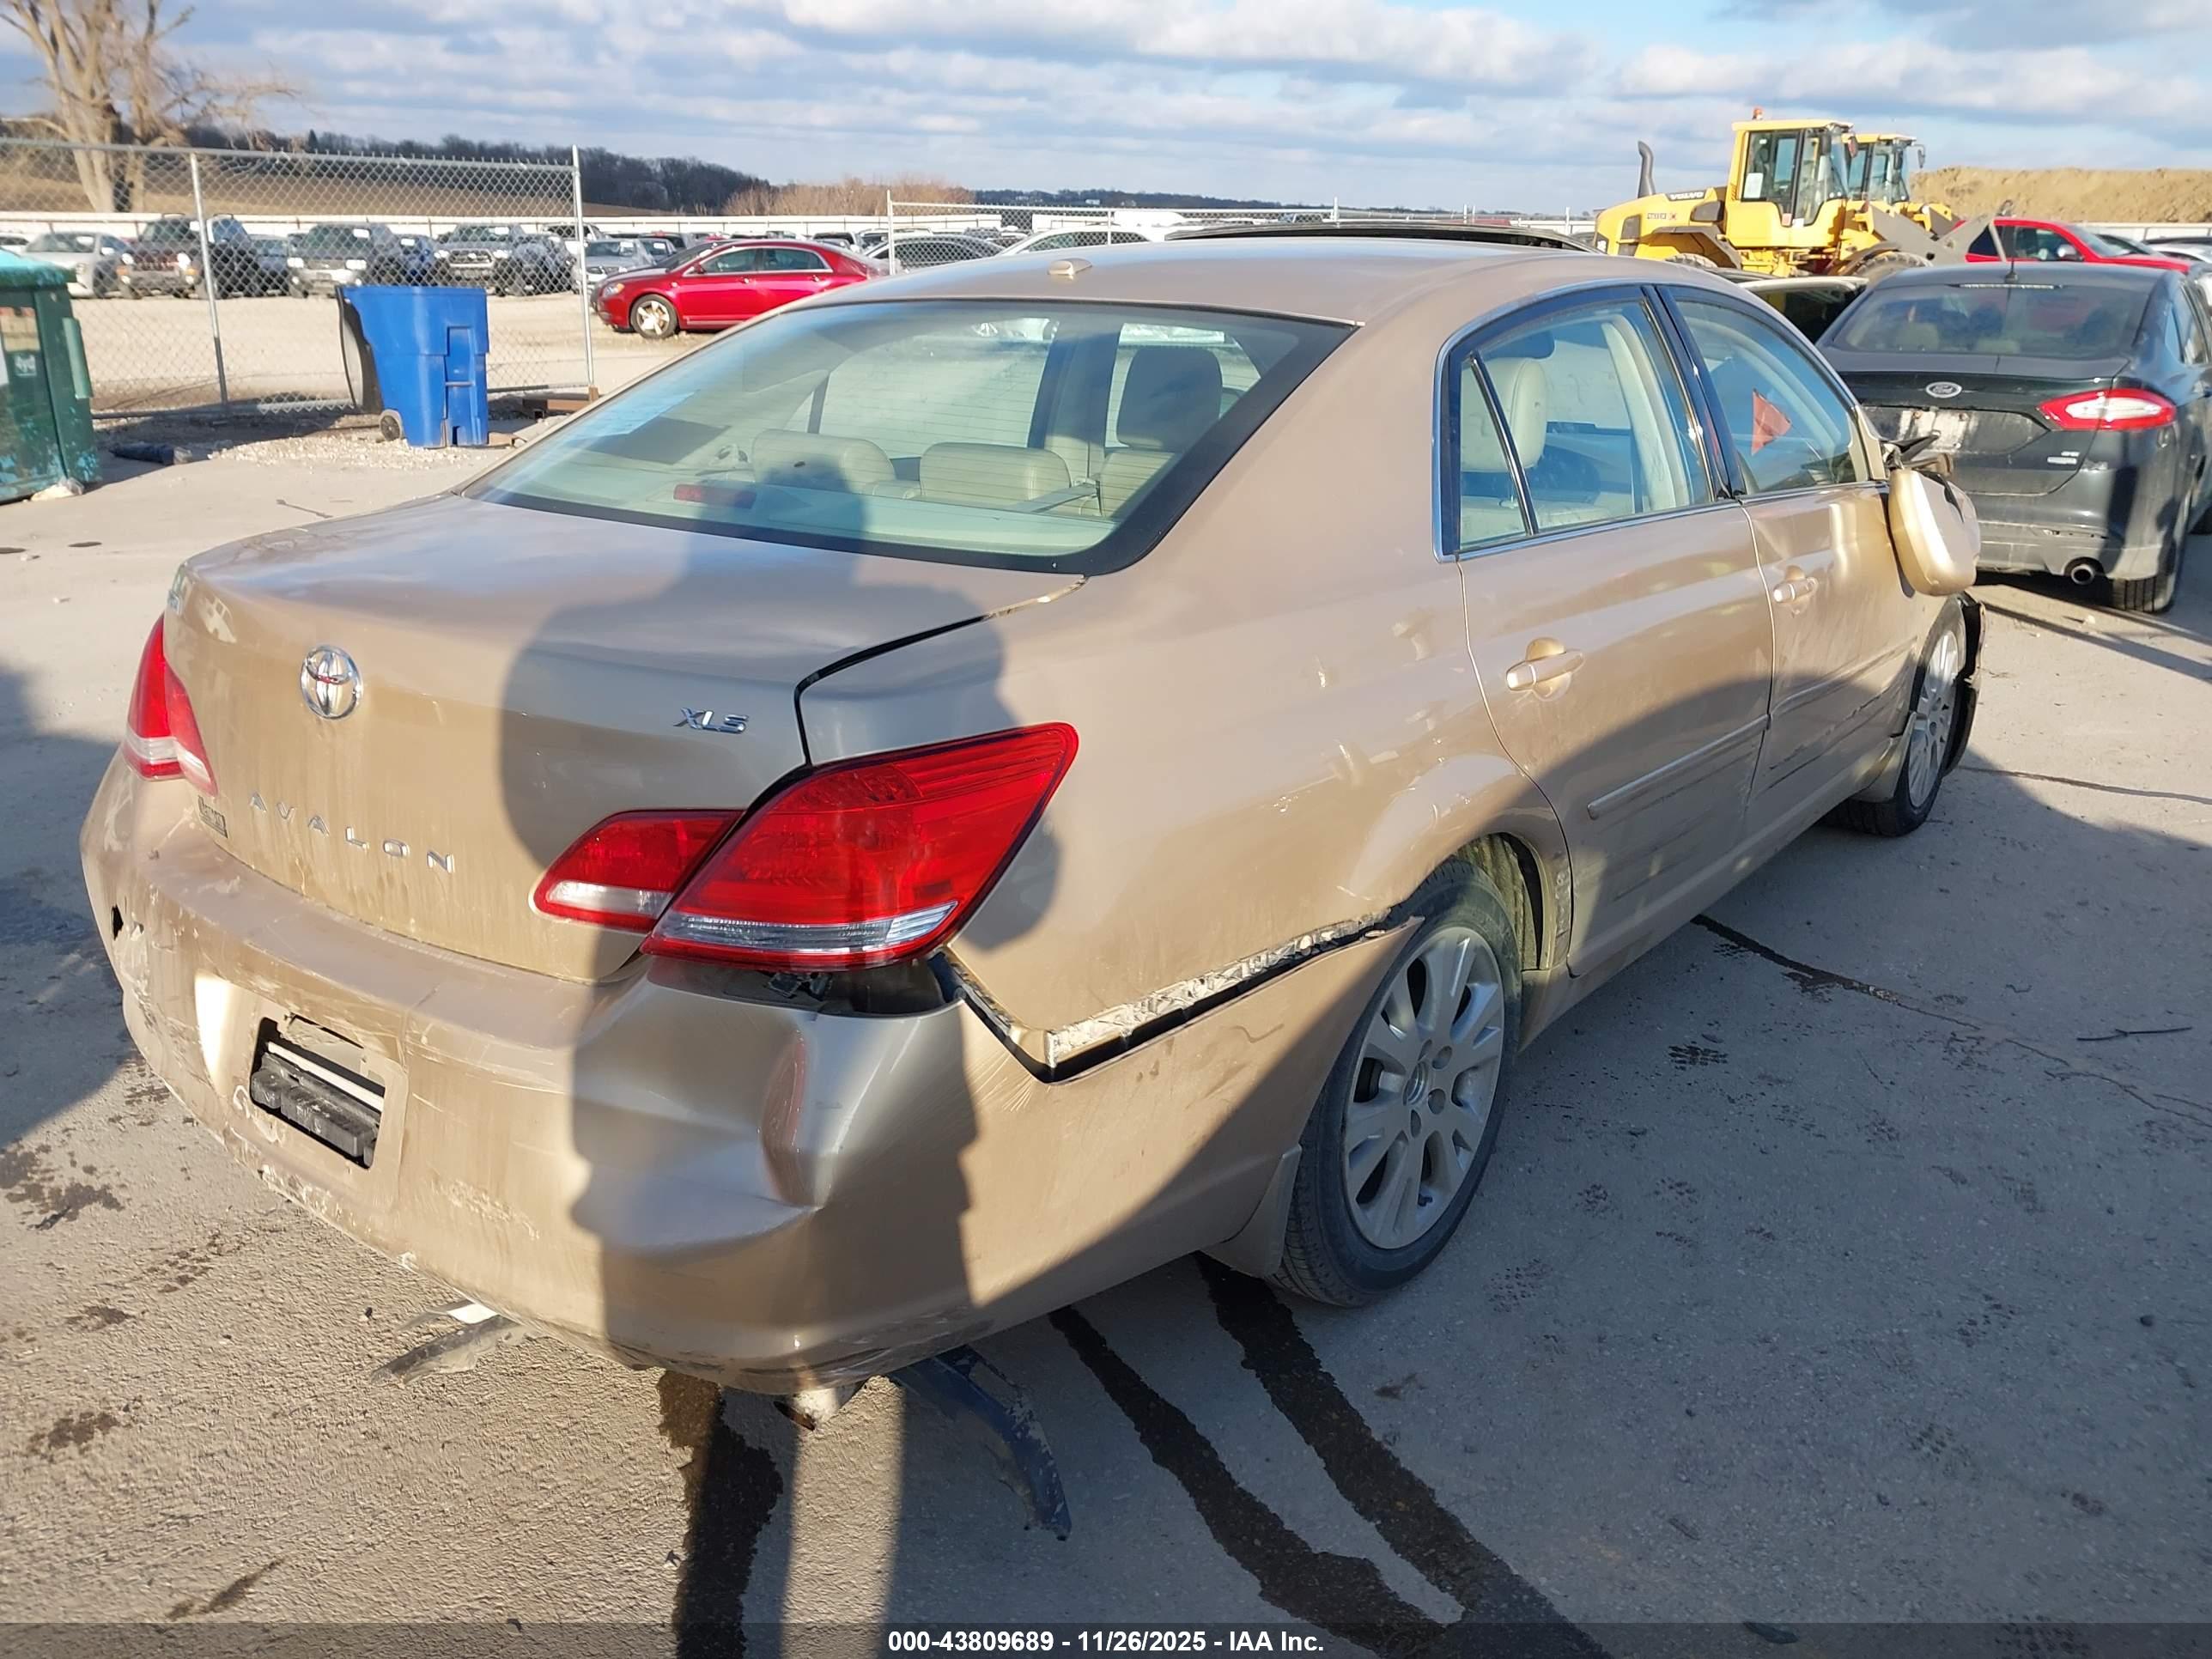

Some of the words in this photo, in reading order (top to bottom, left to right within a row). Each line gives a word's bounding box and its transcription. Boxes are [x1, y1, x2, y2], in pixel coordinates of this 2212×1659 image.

[1669, 191, 1705, 200] VOLVO
[673, 708, 749, 734] XLS
[249, 792, 455, 873] AVALON
